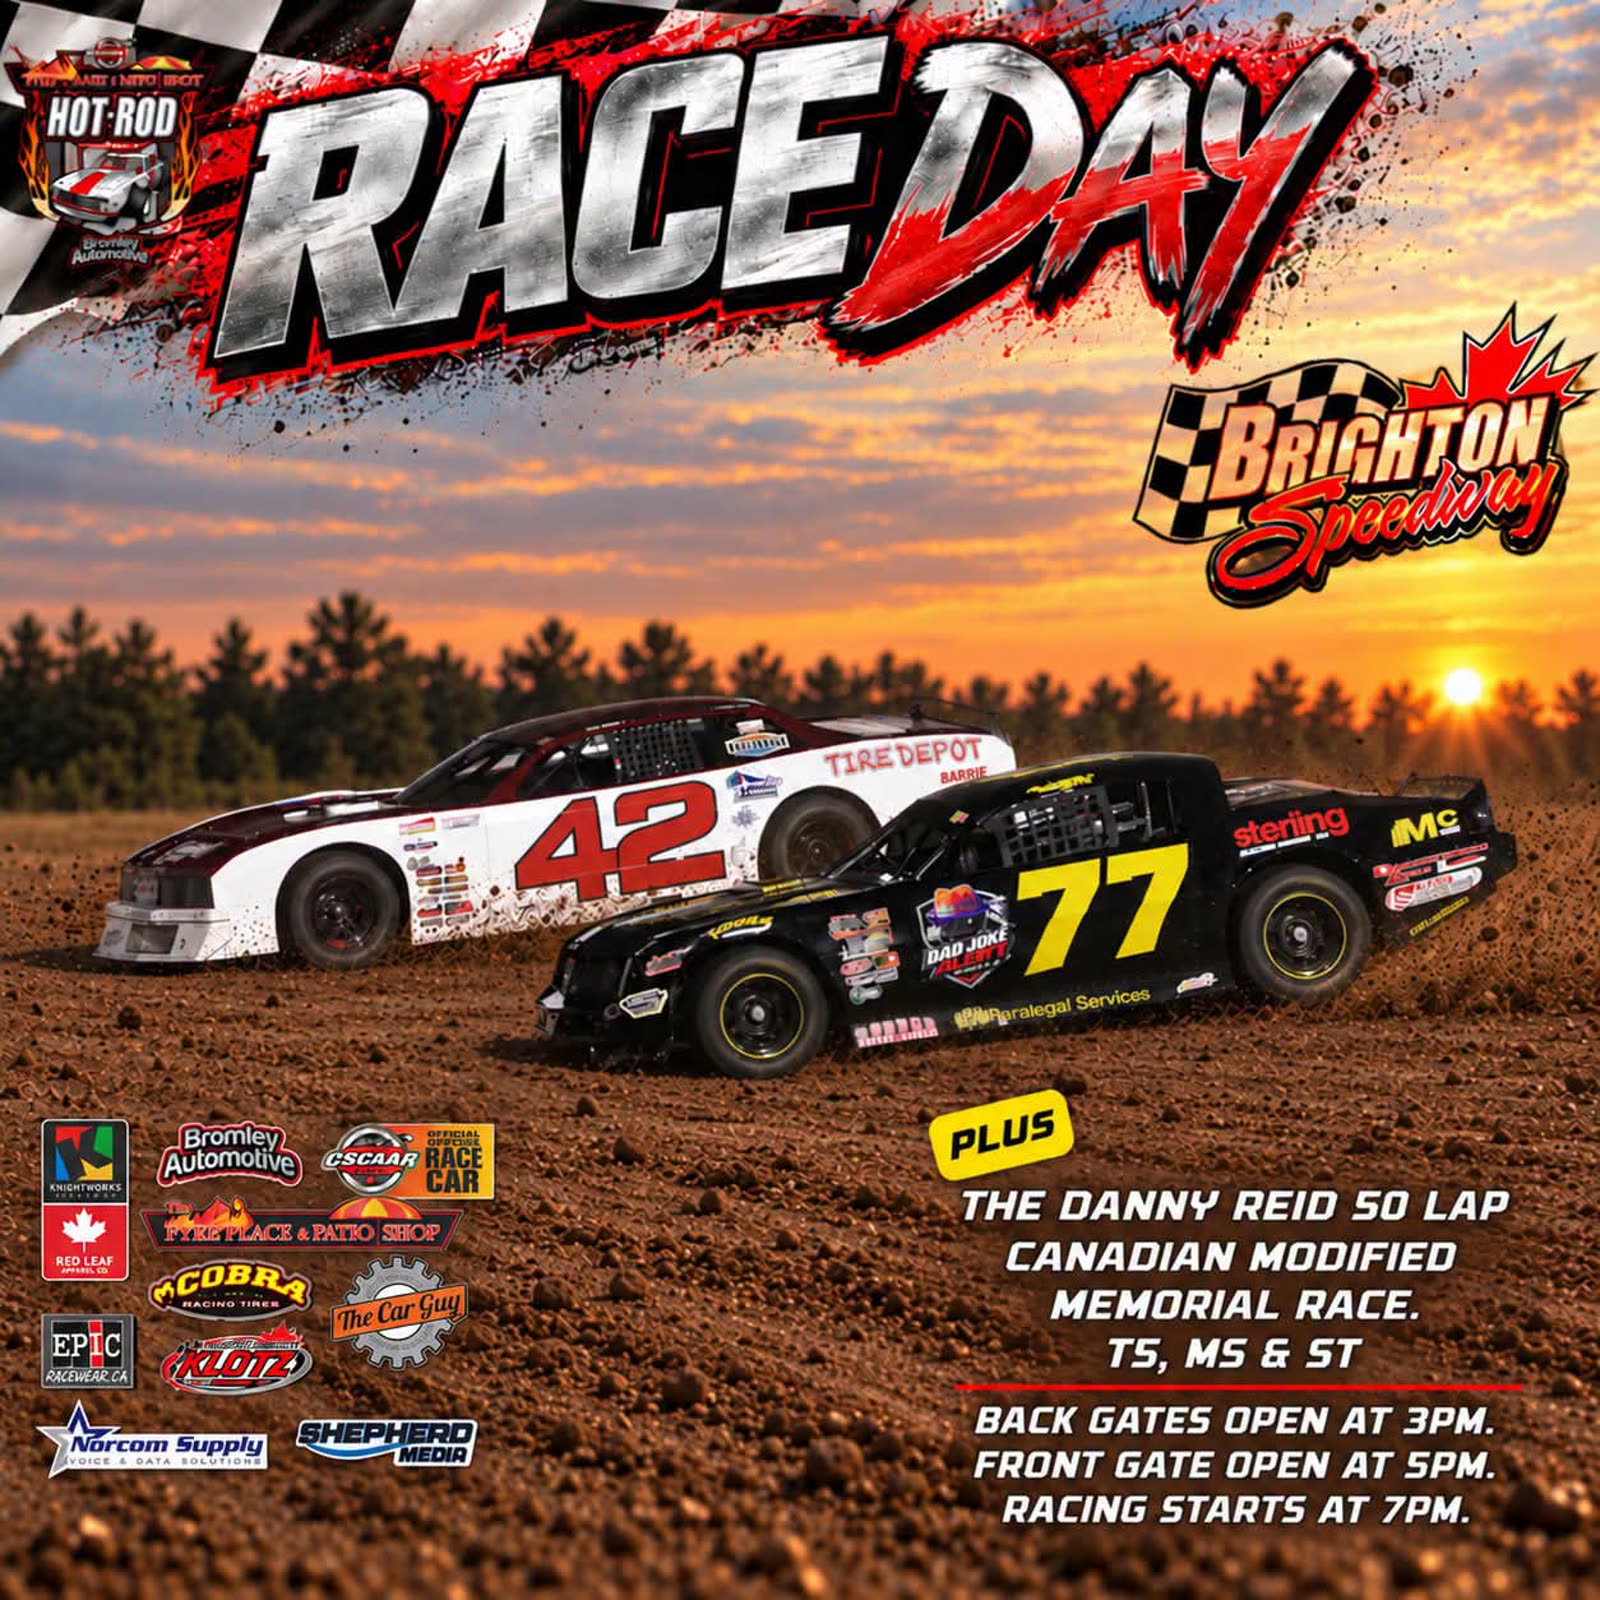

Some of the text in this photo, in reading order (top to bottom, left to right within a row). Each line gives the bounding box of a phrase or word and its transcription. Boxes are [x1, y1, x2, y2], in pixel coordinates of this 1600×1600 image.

[824, 738, 982, 777] TIRE DEPOT
[940, 766, 987, 784] BARRIE
[515, 780, 727, 901] 42
[1017, 843, 1189, 977] 77
[966, 926, 1009, 953] JOKE
[1076, 989, 1151, 1011] Services
